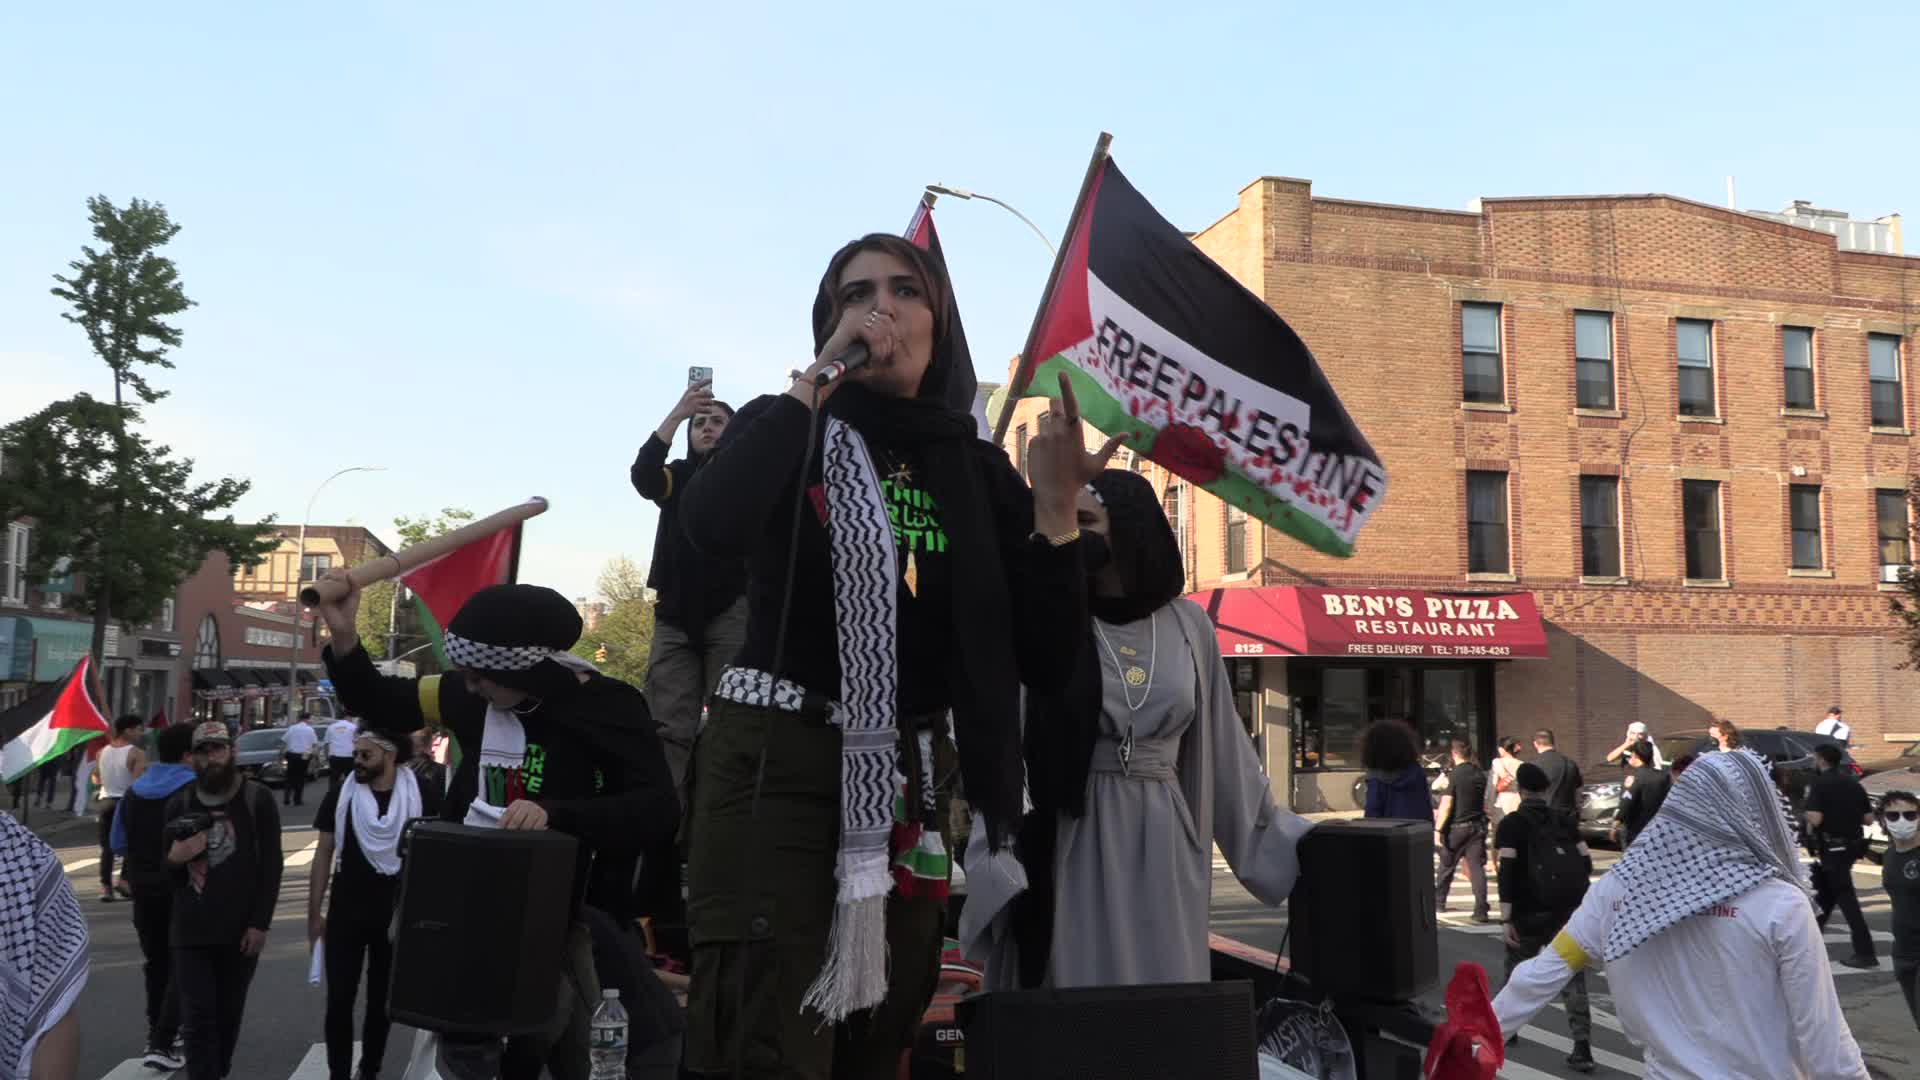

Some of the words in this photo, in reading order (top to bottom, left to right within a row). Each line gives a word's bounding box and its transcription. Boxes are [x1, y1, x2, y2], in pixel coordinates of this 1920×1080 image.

[1097, 316, 1180, 401] FREE
[1321, 593, 1414, 618] BEN'S
[1423, 597, 1520, 620] PIZZA
[1354, 619, 1496, 637] RESTAURANT
[1234, 643, 1264, 654] 8125
[1348, 644, 1374, 654] FREE
[1376, 644, 1425, 655] DELIVERY
[1431, 645, 1452, 655] TEL:
